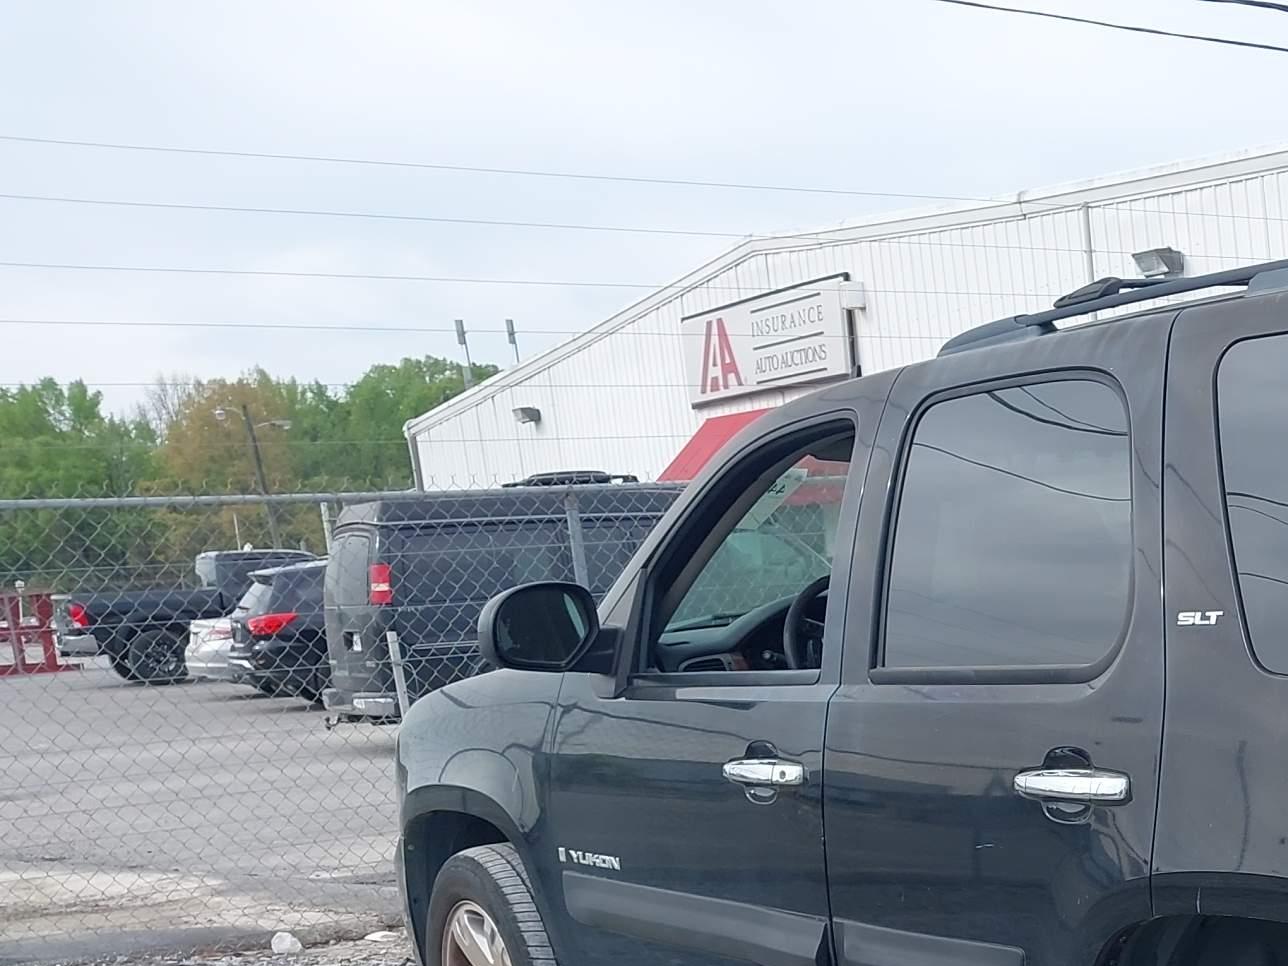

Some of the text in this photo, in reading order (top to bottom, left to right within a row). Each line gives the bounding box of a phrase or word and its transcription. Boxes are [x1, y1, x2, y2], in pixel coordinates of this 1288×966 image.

[751, 304, 824, 337] INSURANCE
[755, 343, 828, 375] AUTO AUCTIONS
[1177, 610, 1224, 626] SLT
[568, 849, 621, 871] YUKON
